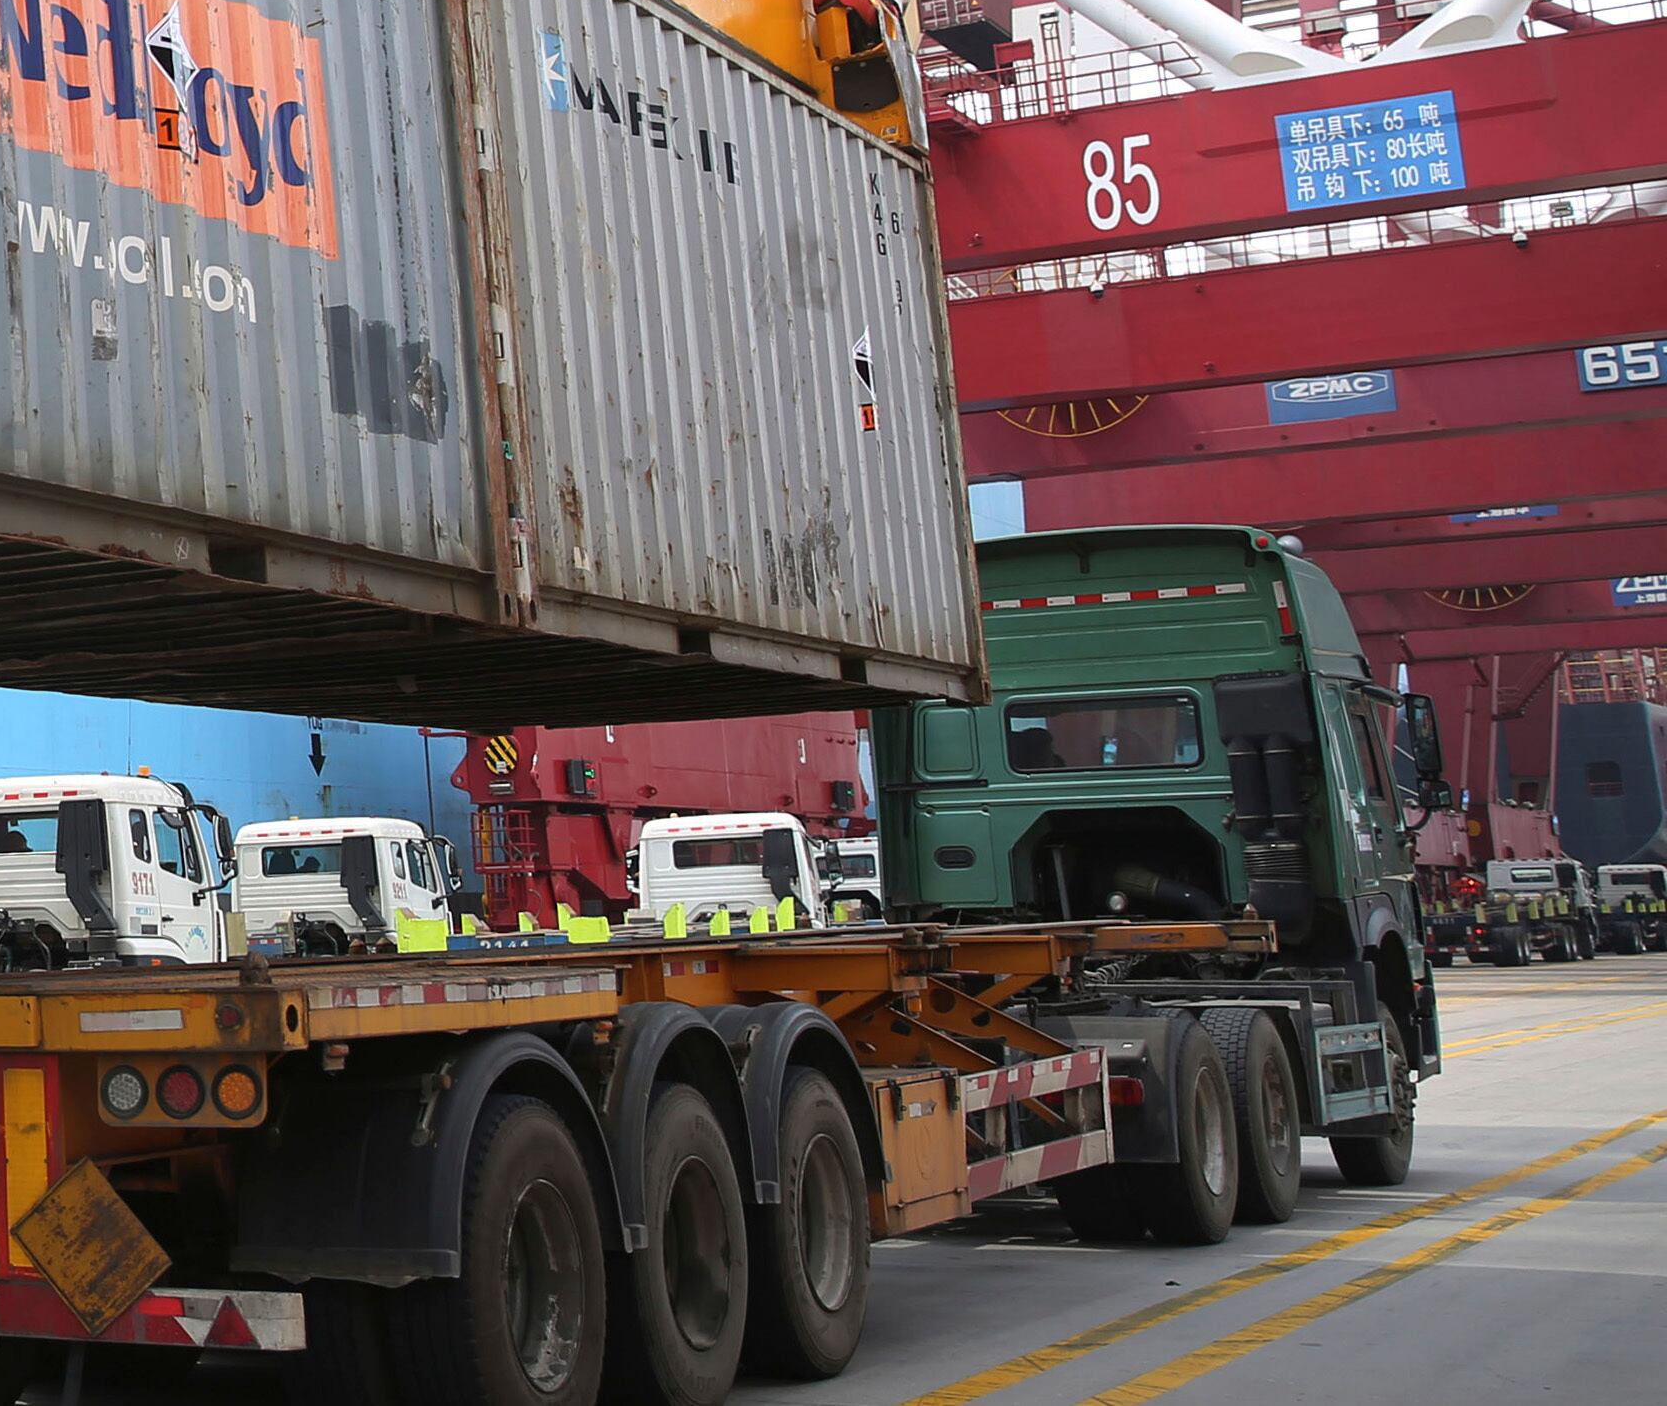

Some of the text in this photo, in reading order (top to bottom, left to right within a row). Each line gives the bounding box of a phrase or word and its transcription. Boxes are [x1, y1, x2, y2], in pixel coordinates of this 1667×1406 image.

[1083, 133, 1160, 231] 85
[1583, 341, 1667, 385] 65
[1288, 377, 1373, 399] ZPMC
